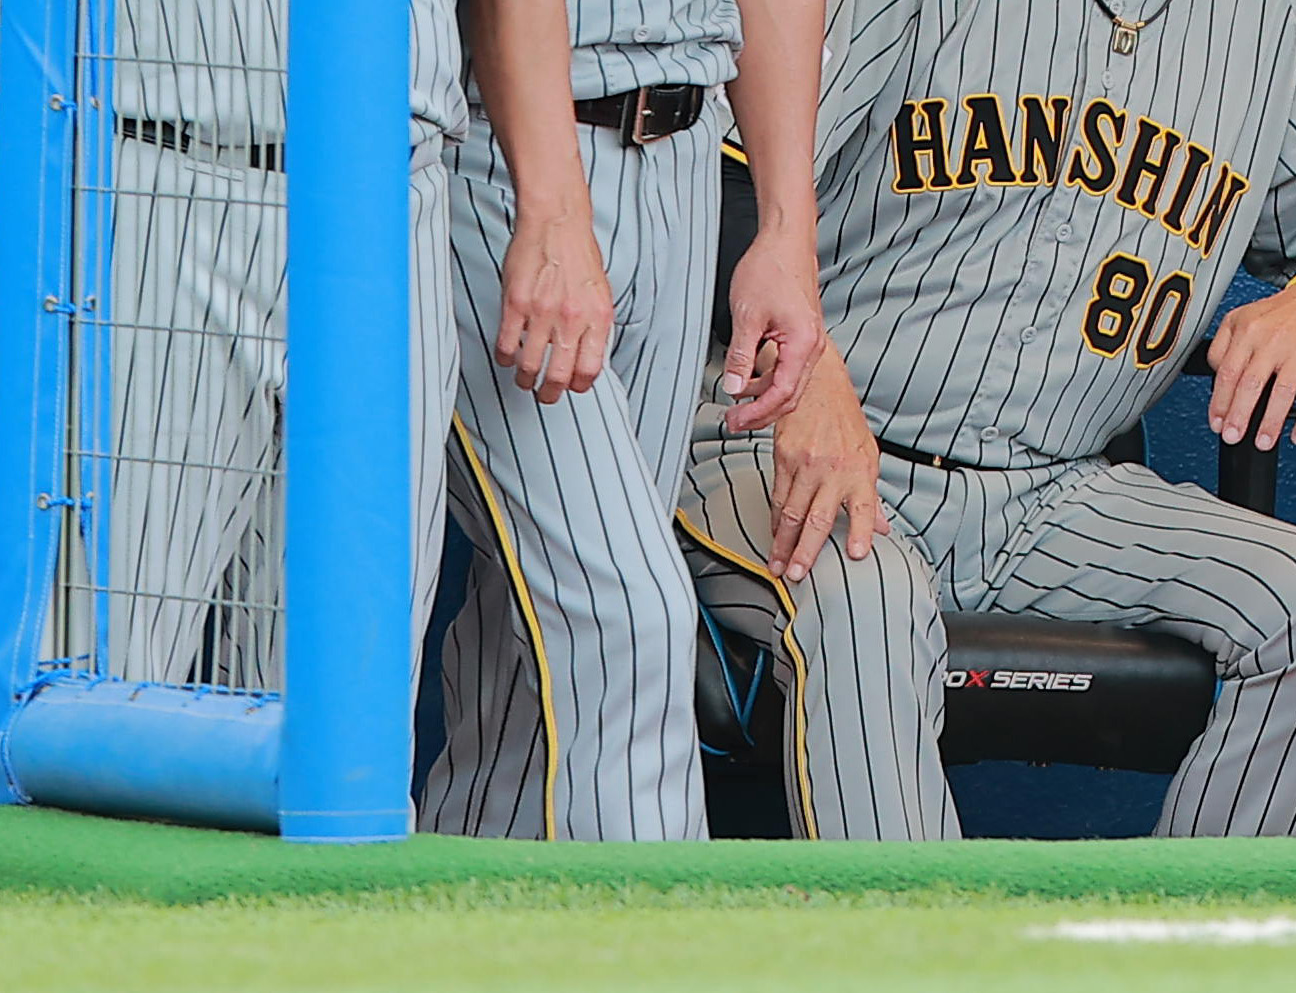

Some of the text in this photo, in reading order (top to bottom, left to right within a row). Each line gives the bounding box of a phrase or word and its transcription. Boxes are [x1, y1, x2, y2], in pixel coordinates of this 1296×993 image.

[892, 93, 1250, 258] HANSHIN
[1081, 251, 1194, 370] 80
[990, 671, 1093, 691] SERIES
